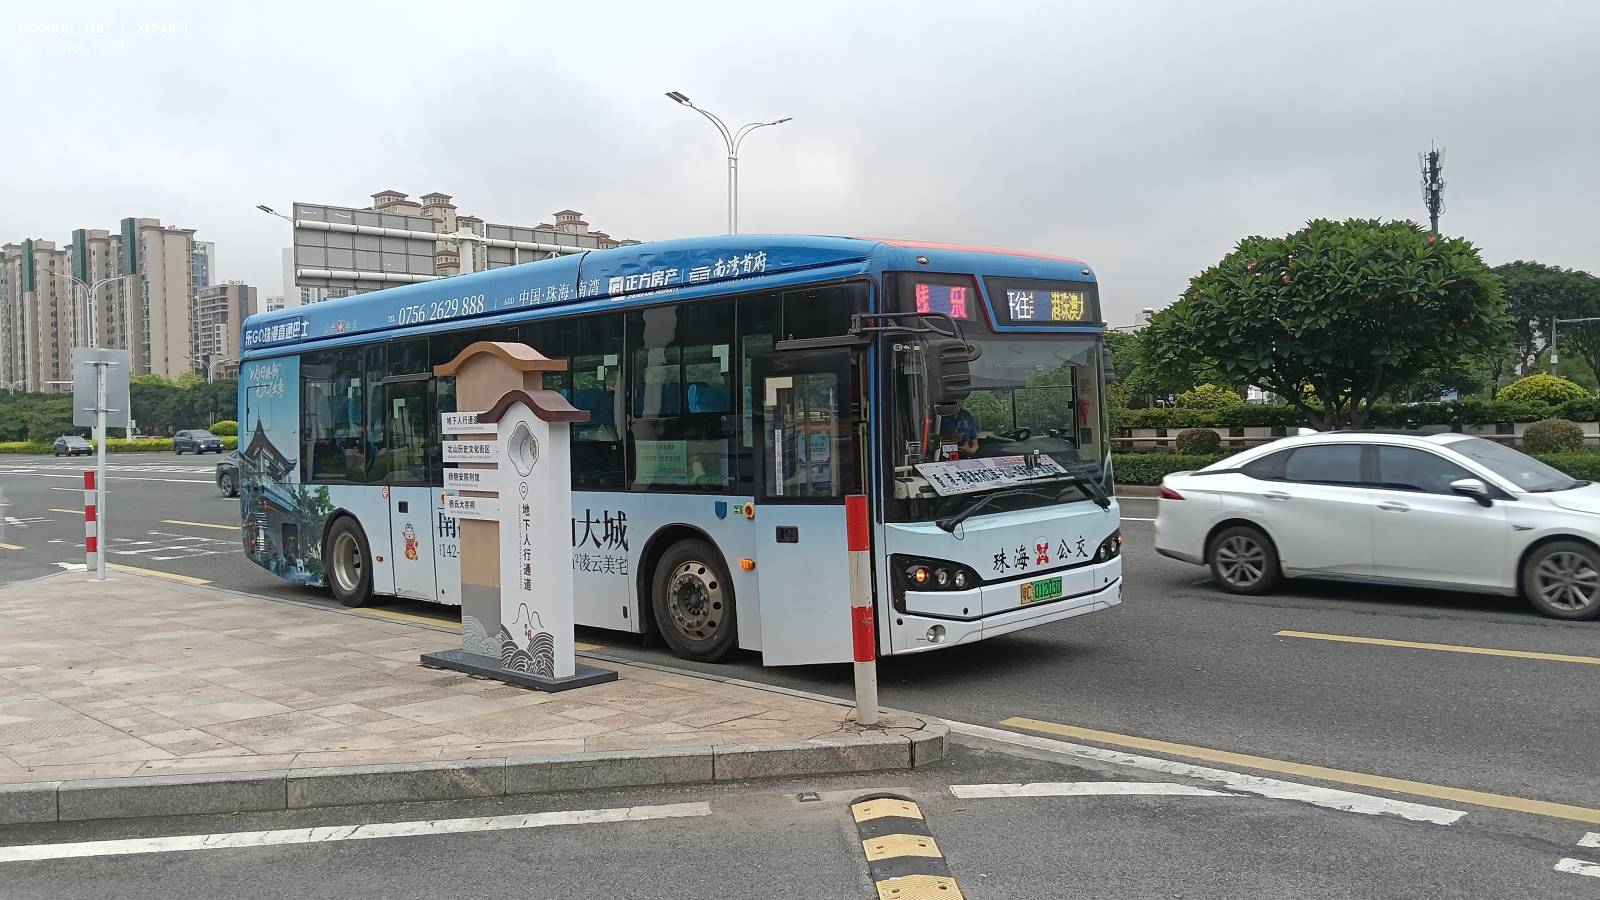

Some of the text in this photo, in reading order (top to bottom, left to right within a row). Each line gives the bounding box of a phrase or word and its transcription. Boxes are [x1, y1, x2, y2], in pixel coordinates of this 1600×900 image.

[624, 268, 678, 291] 正方房产
[713, 251, 767, 278] 南湾首府
[398, 303, 426, 325] 0756
[430, 298, 459, 320] 2629
[461, 294, 485, 316] 888
[448, 443, 490, 455] 北山历史文化街区
[571, 508, 629, 552] 大城
[522, 503, 532, 591] 地下人行通道
[992, 535, 1089, 574] 珠海 公交
